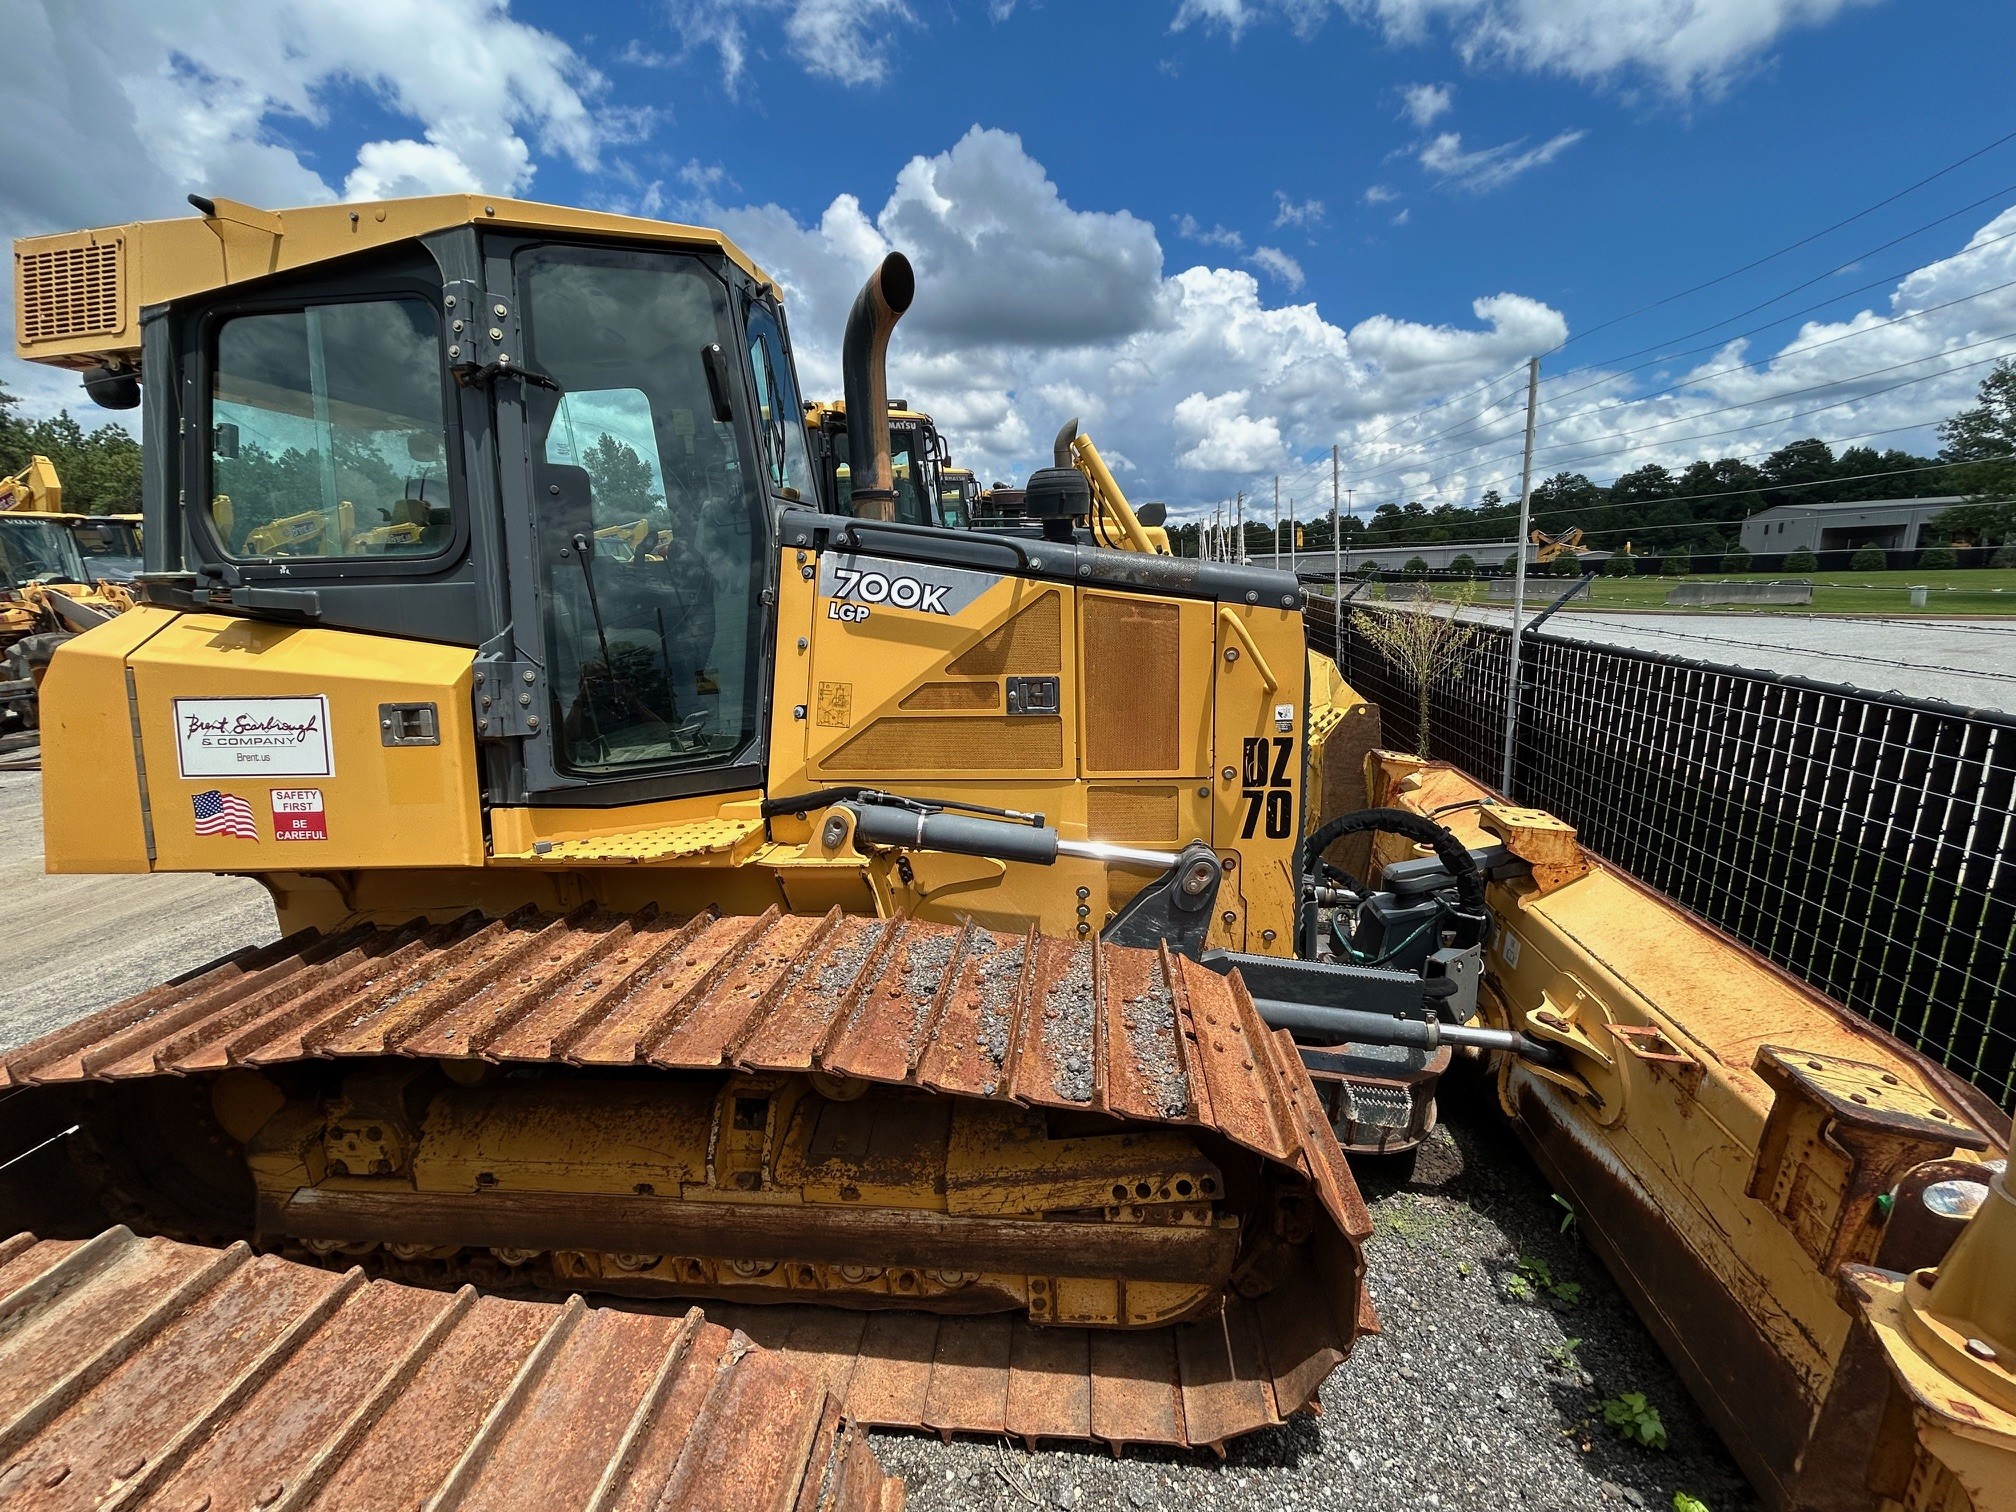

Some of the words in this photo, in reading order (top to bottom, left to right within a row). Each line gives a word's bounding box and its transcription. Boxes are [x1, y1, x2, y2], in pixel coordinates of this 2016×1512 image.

[888, 421, 917, 430] MATSU
[831, 567, 954, 616] 700K
[827, 602, 871, 624] LGP
[184, 713, 229, 740] Brent
[233, 714, 318, 743] Scarbrough
[202, 738, 213, 746] &
[217, 737, 296, 746] COMPANY
[236, 753, 271, 762] Brent.us
[1242, 736, 1294, 788] DZ
[276, 791, 318, 800] SAFETY
[283, 802, 313, 811] FIRST
[1240, 790, 1293, 840] 70
[292, 819, 308, 828] BE
[276, 830, 327, 840] CAREFUL
